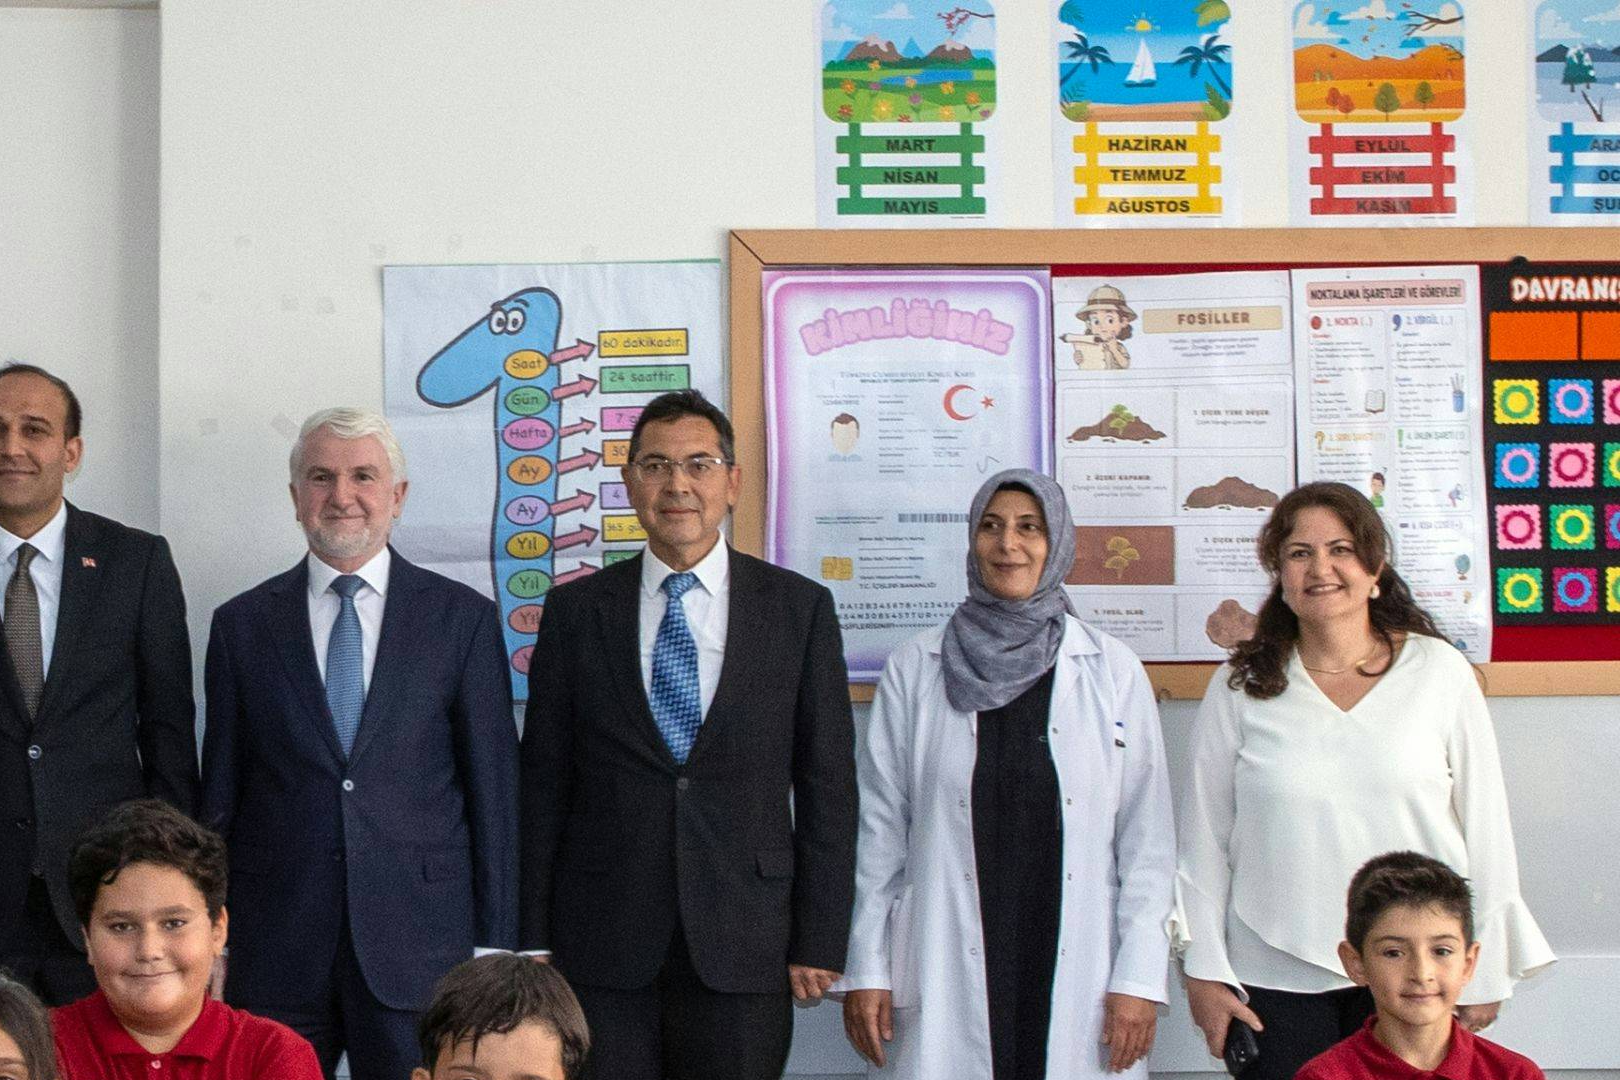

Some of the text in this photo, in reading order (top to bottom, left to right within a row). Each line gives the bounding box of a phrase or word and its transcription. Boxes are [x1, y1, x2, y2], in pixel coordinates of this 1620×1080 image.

[886, 139, 936, 153] MART
[1107, 137, 1187, 152] HAZİRAN
[1355, 138, 1410, 152] EYLÜL
[883, 168, 938, 184] NİSAN
[1109, 168, 1186, 182] TEMMUZ
[1361, 169, 1406, 184] EKİM
[883, 200, 939, 214] MAYIS
[1107, 197, 1191, 213] AĞUSTOS
[1356, 200, 1412, 214] KASIM
[1310, 287, 1360, 300] NOKTALAMA
[1408, 286, 1418, 299] VE
[1511, 276, 1620, 303] DAVRANI
[1177, 311, 1250, 326] FOSİLLER
[602, 337, 618, 349] 60
[511, 358, 542, 370] Saat
[609, 371, 625, 383] 24
[511, 393, 539, 406] Gün
[509, 426, 548, 439] Hafta
[518, 463, 540, 479] Ay
[516, 504, 539, 520] Ay
[516, 536, 538, 552] Yıl
[519, 575, 540, 590] Yıl
